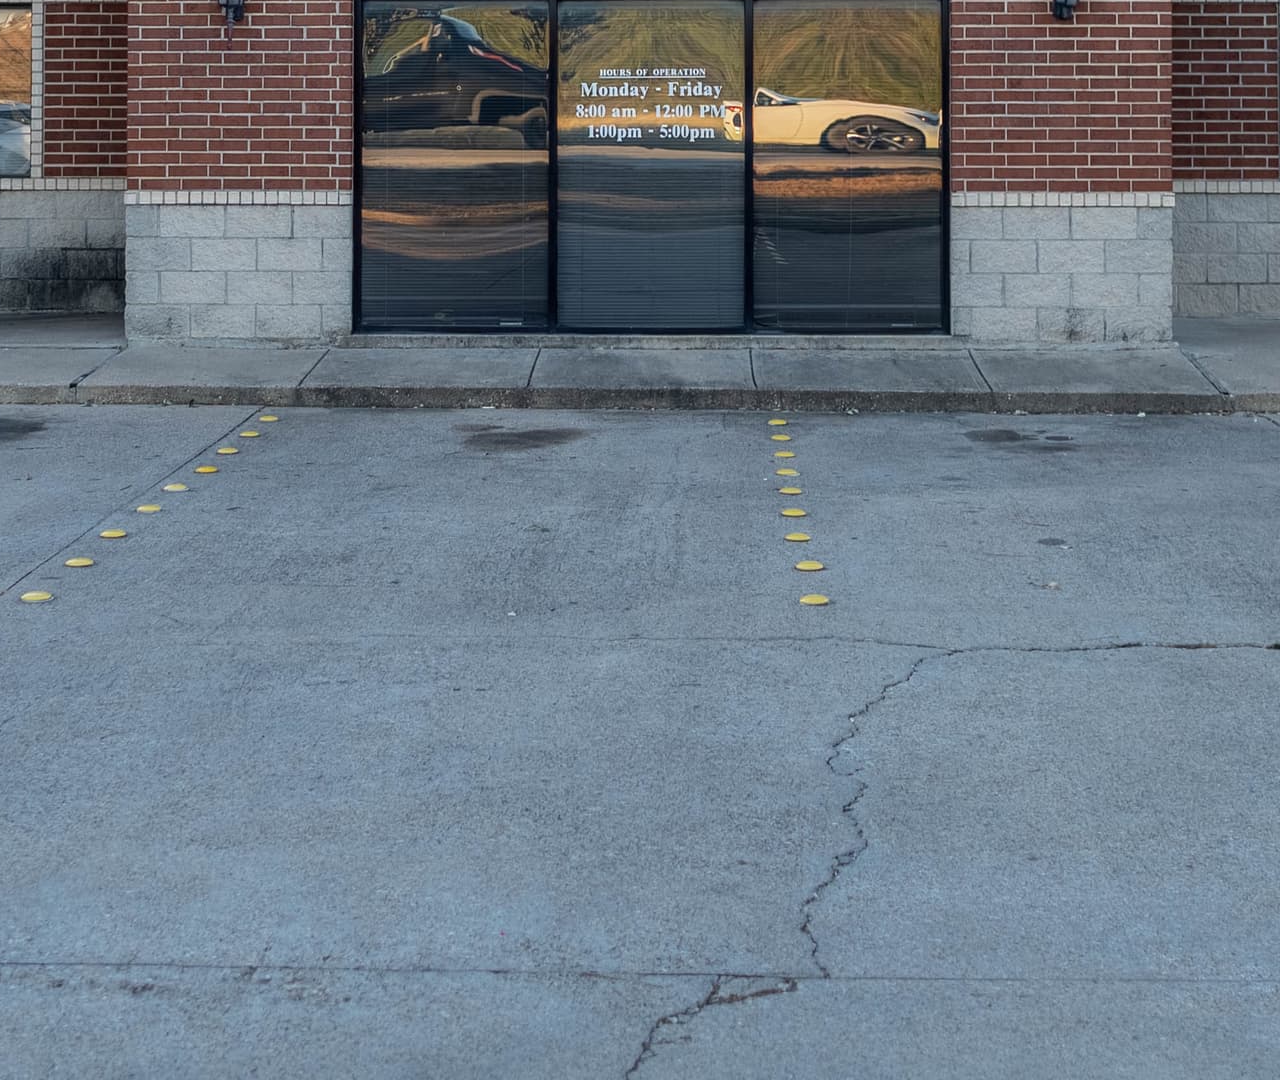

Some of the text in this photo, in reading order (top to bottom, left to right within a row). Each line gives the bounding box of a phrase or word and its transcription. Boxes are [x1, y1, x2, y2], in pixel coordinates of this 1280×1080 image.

[600, 68, 706, 76] HOURS OF OPERATION
[581, 82, 649, 99] Monday
[667, 81, 723, 99] Friday
[575, 104, 606, 118] 8:00
[612, 107, 637, 118] am
[655, 105, 693, 118] 12:00
[699, 105, 726, 118] PM
[588, 125, 642, 142] 1:00pm
[659, 125, 715, 142] 5:00pm
